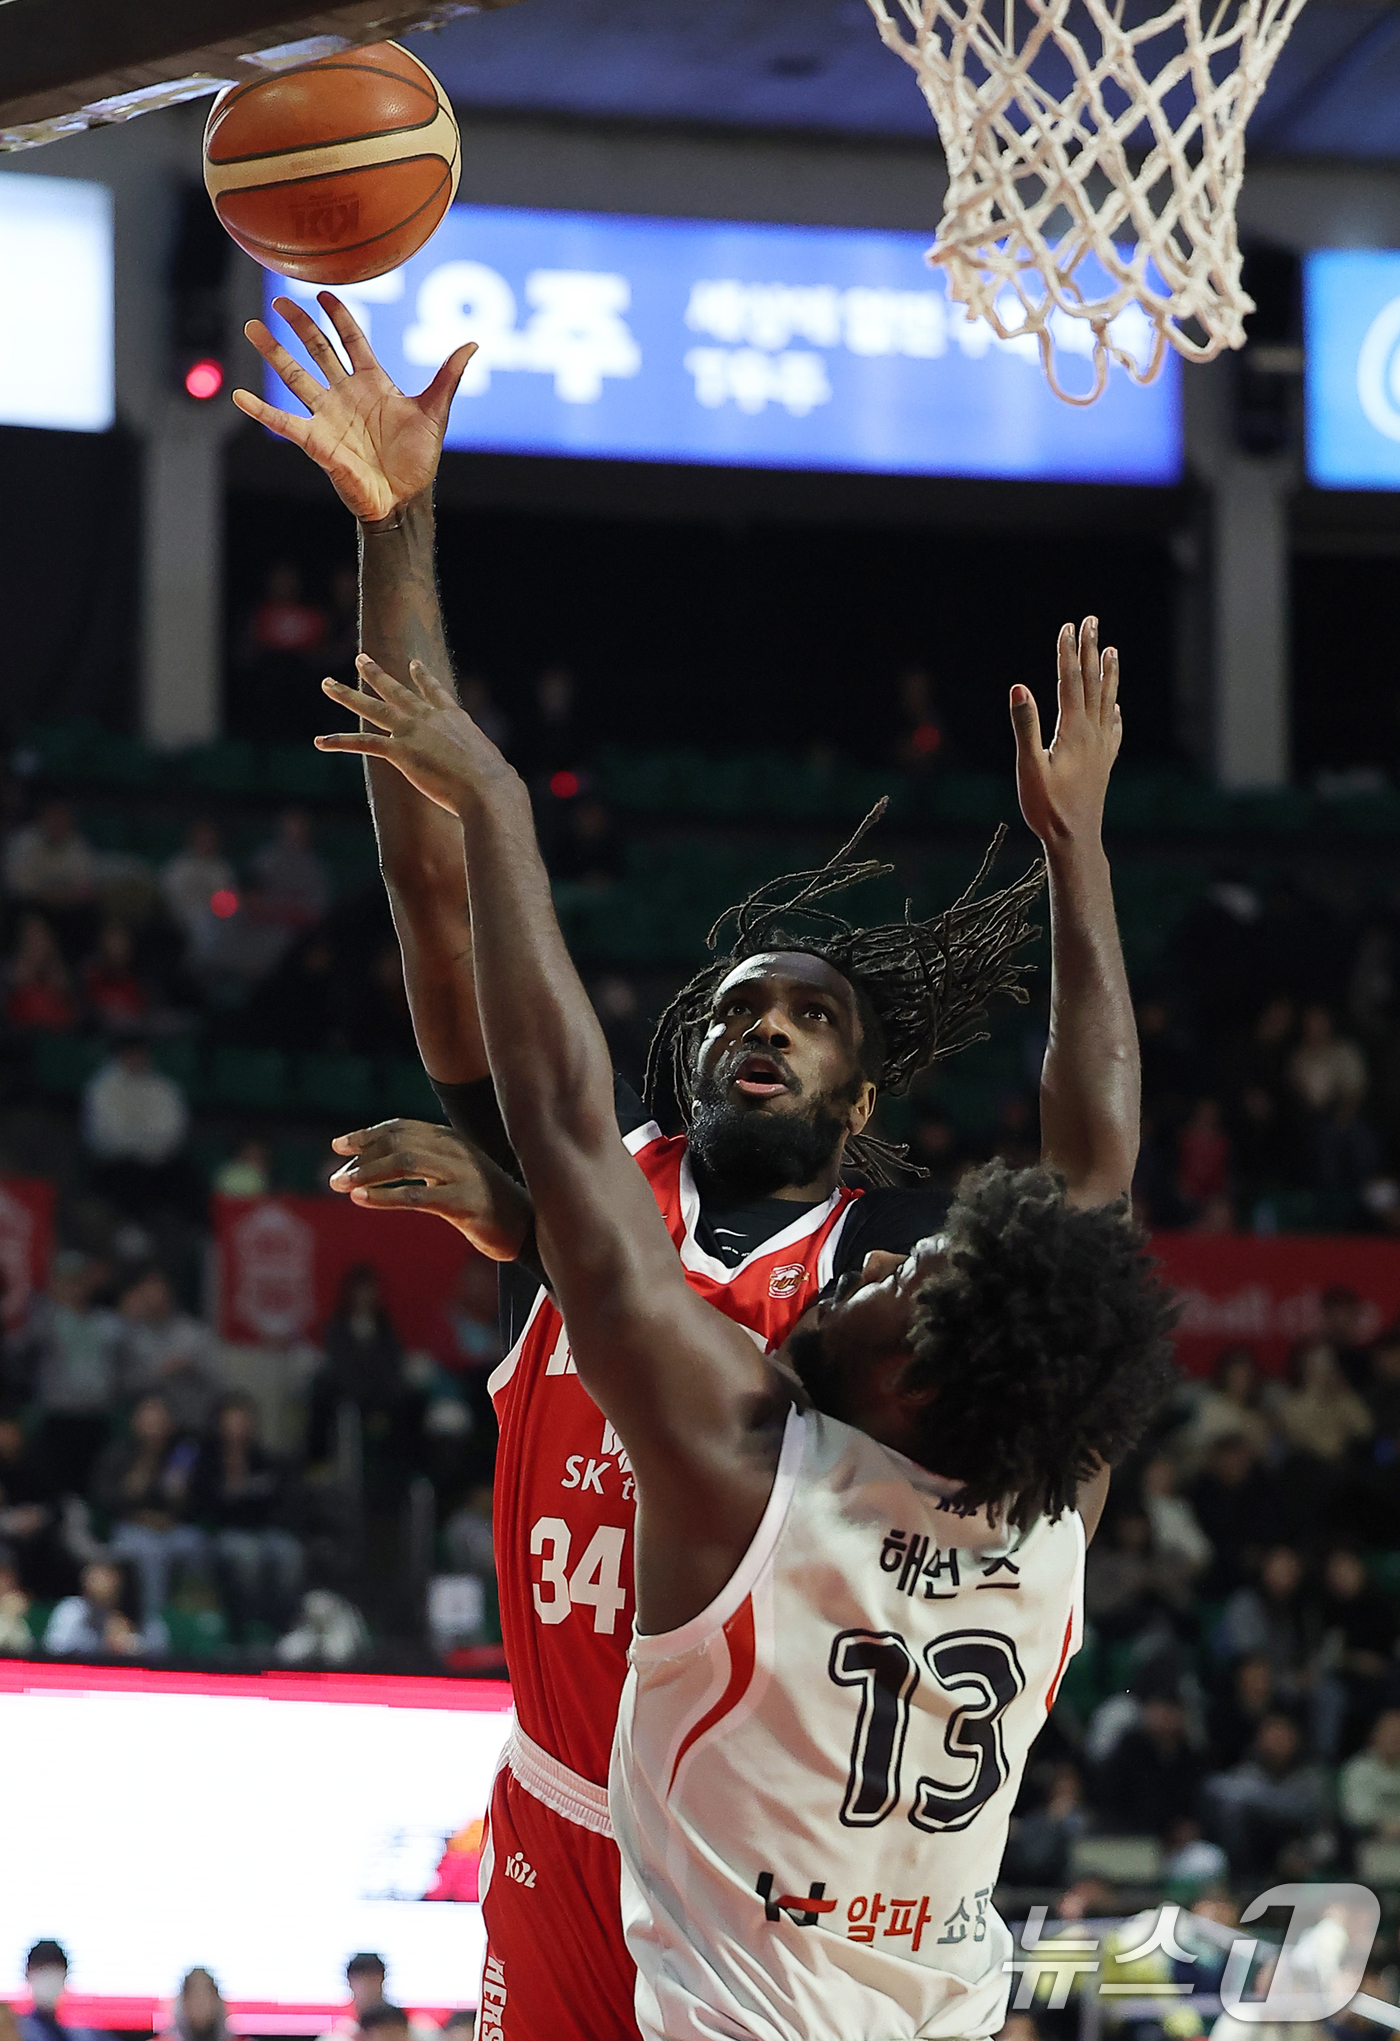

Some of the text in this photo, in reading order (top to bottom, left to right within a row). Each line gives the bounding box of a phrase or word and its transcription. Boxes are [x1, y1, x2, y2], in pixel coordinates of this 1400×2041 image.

[561, 1454, 611, 1495] SK
[530, 1516, 626, 1634] 34
[829, 1629, 1025, 1833] 13
[847, 1893, 931, 1951] 알파
